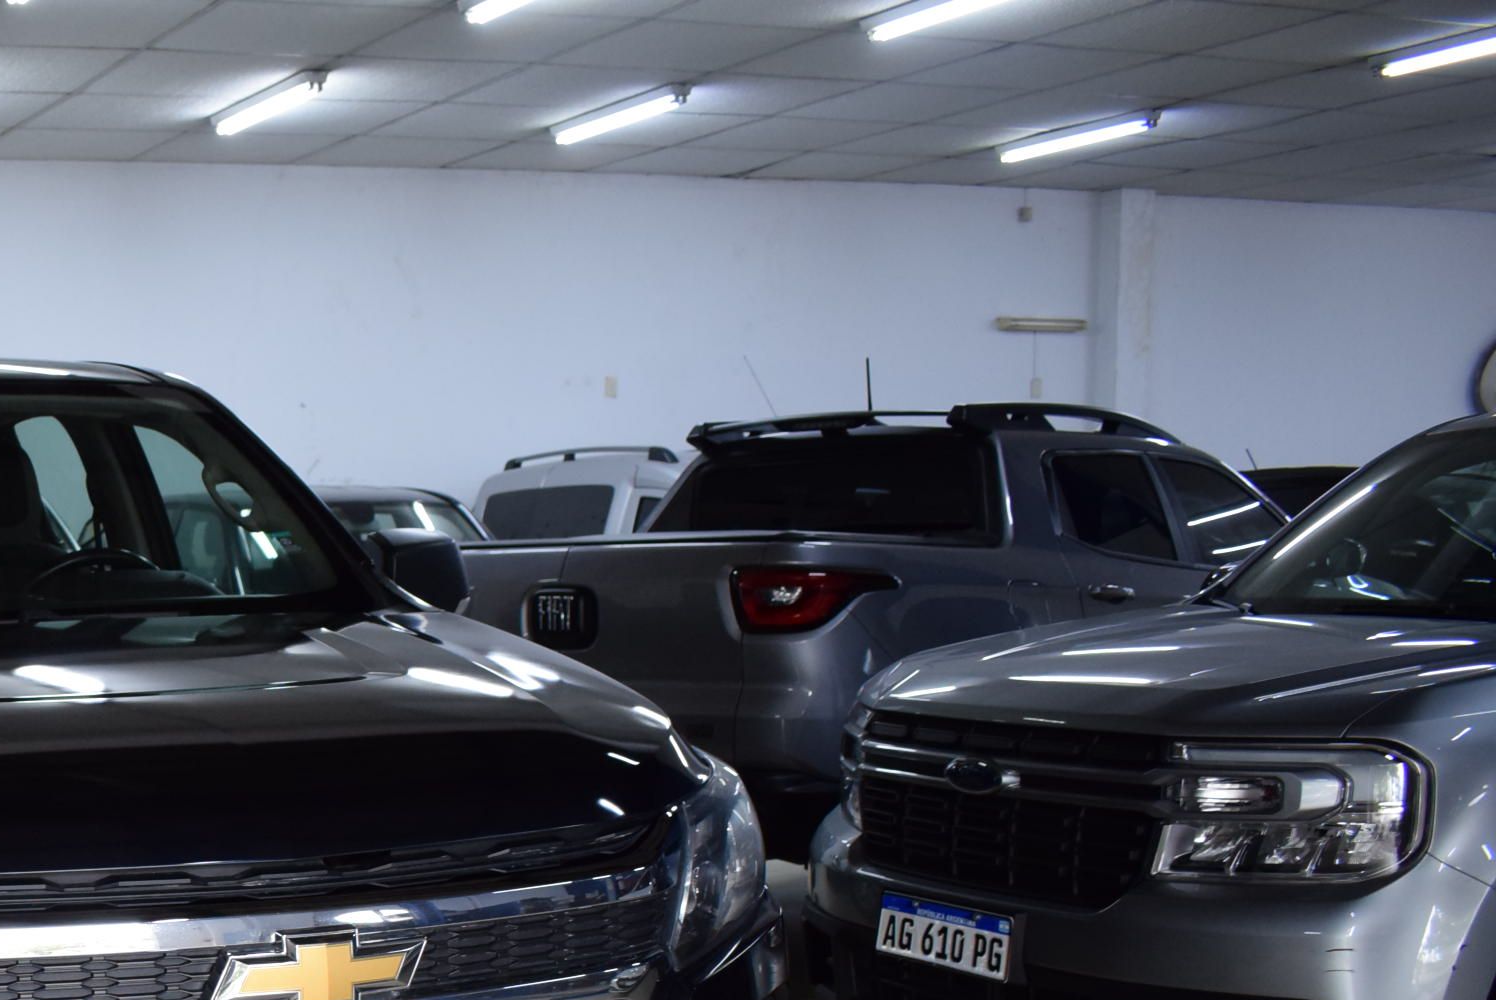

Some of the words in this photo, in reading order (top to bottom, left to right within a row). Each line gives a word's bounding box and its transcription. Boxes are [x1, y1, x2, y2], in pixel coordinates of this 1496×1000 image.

[538, 595, 574, 631] FIAT
[883, 915, 913, 951] AG
[921, 923, 964, 963] 610
[972, 934, 1002, 973] PG
